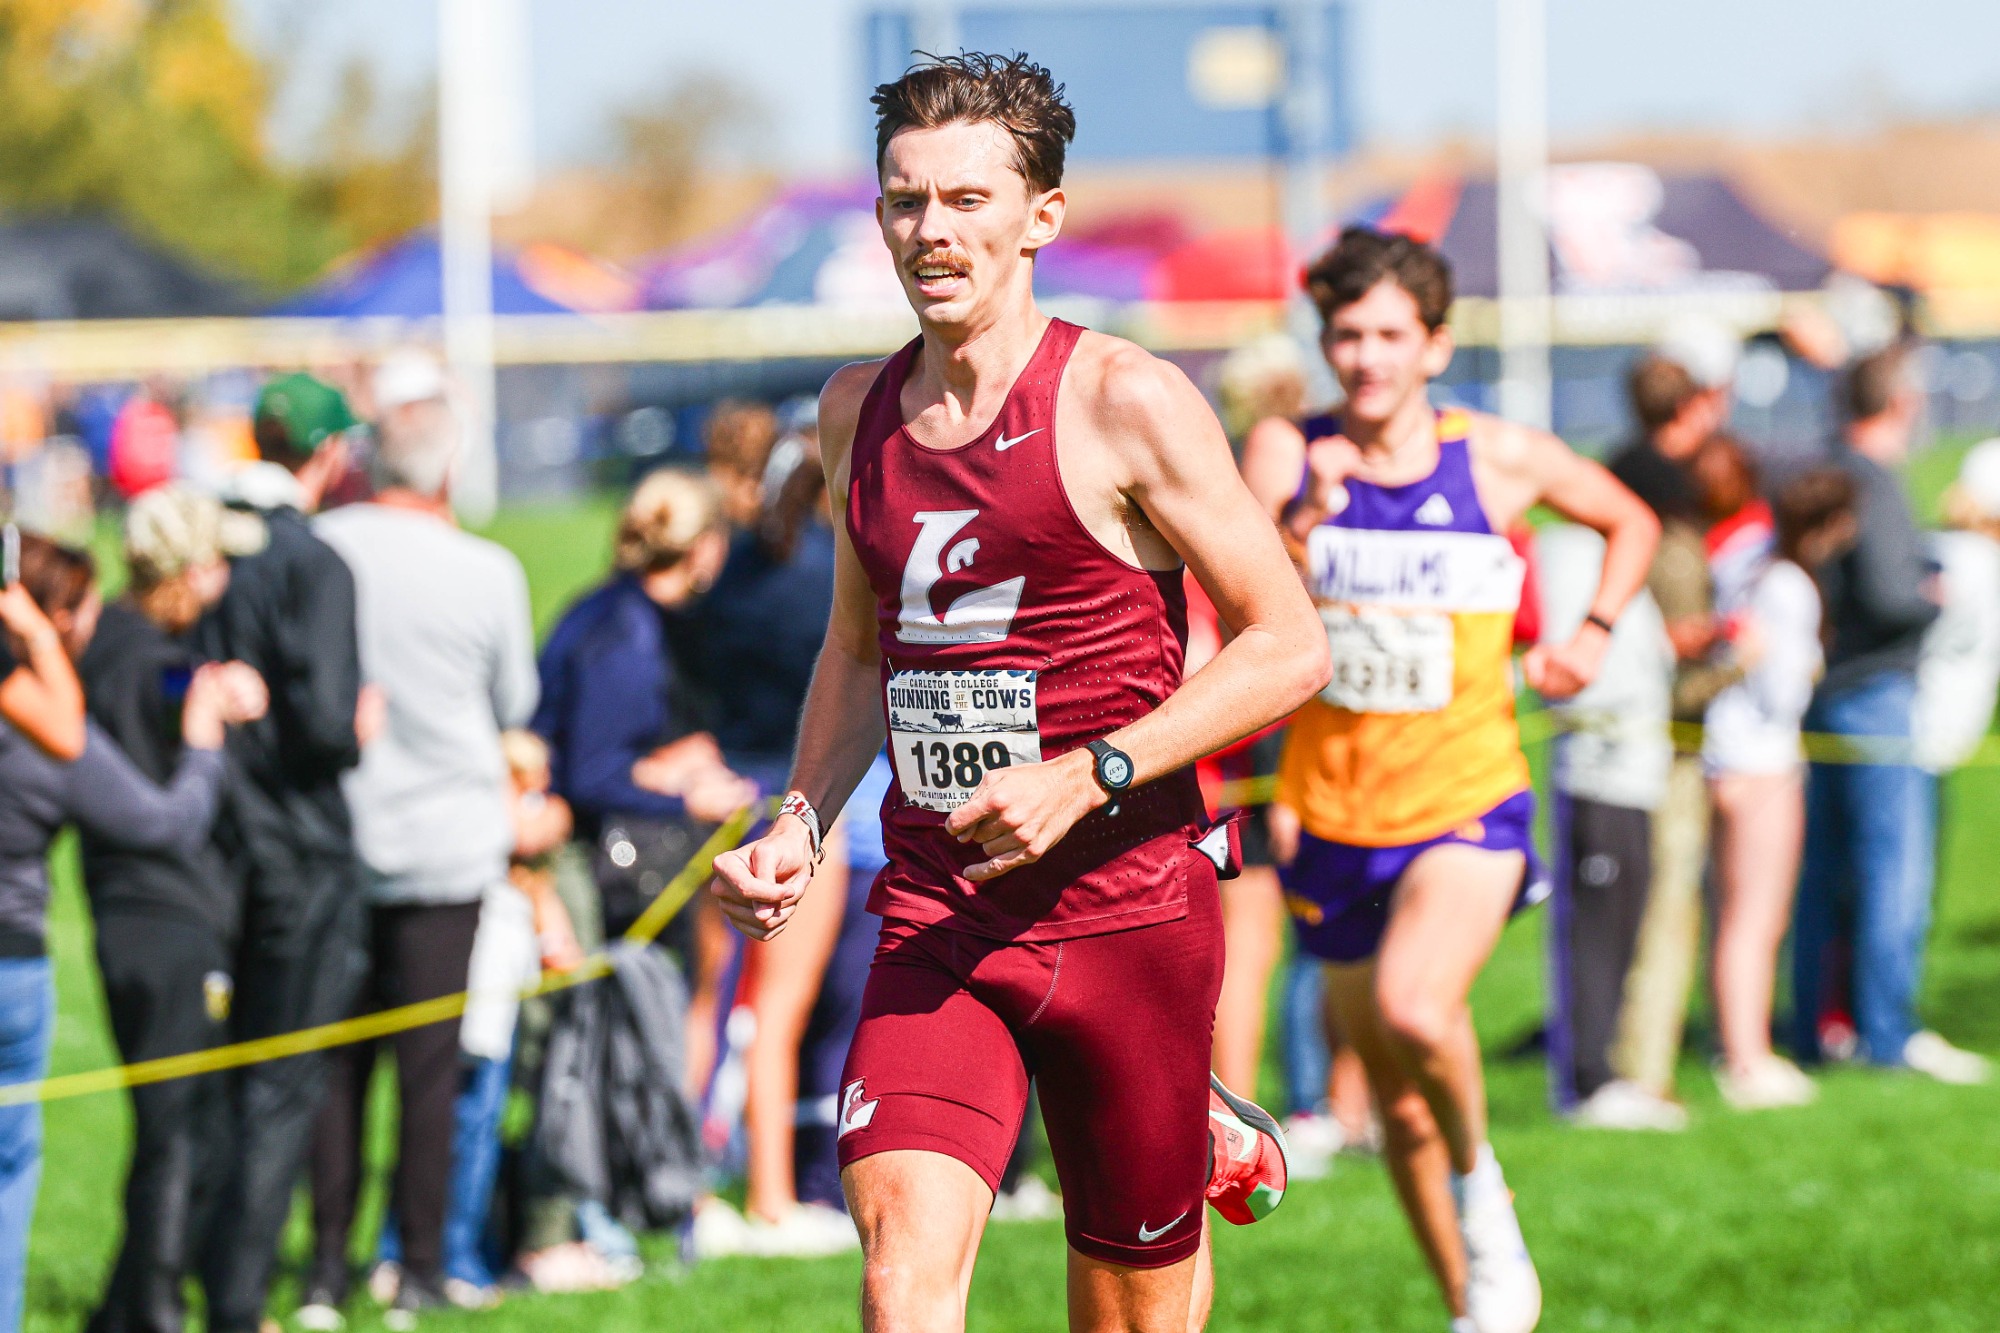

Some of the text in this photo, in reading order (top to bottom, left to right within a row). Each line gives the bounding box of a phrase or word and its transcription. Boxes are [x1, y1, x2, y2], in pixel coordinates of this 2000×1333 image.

[909, 678, 999, 689] CARLETON COLLEGE
[890, 687, 1032, 710] RUNNING OF THE COWS
[910, 740, 1012, 789] 1389
